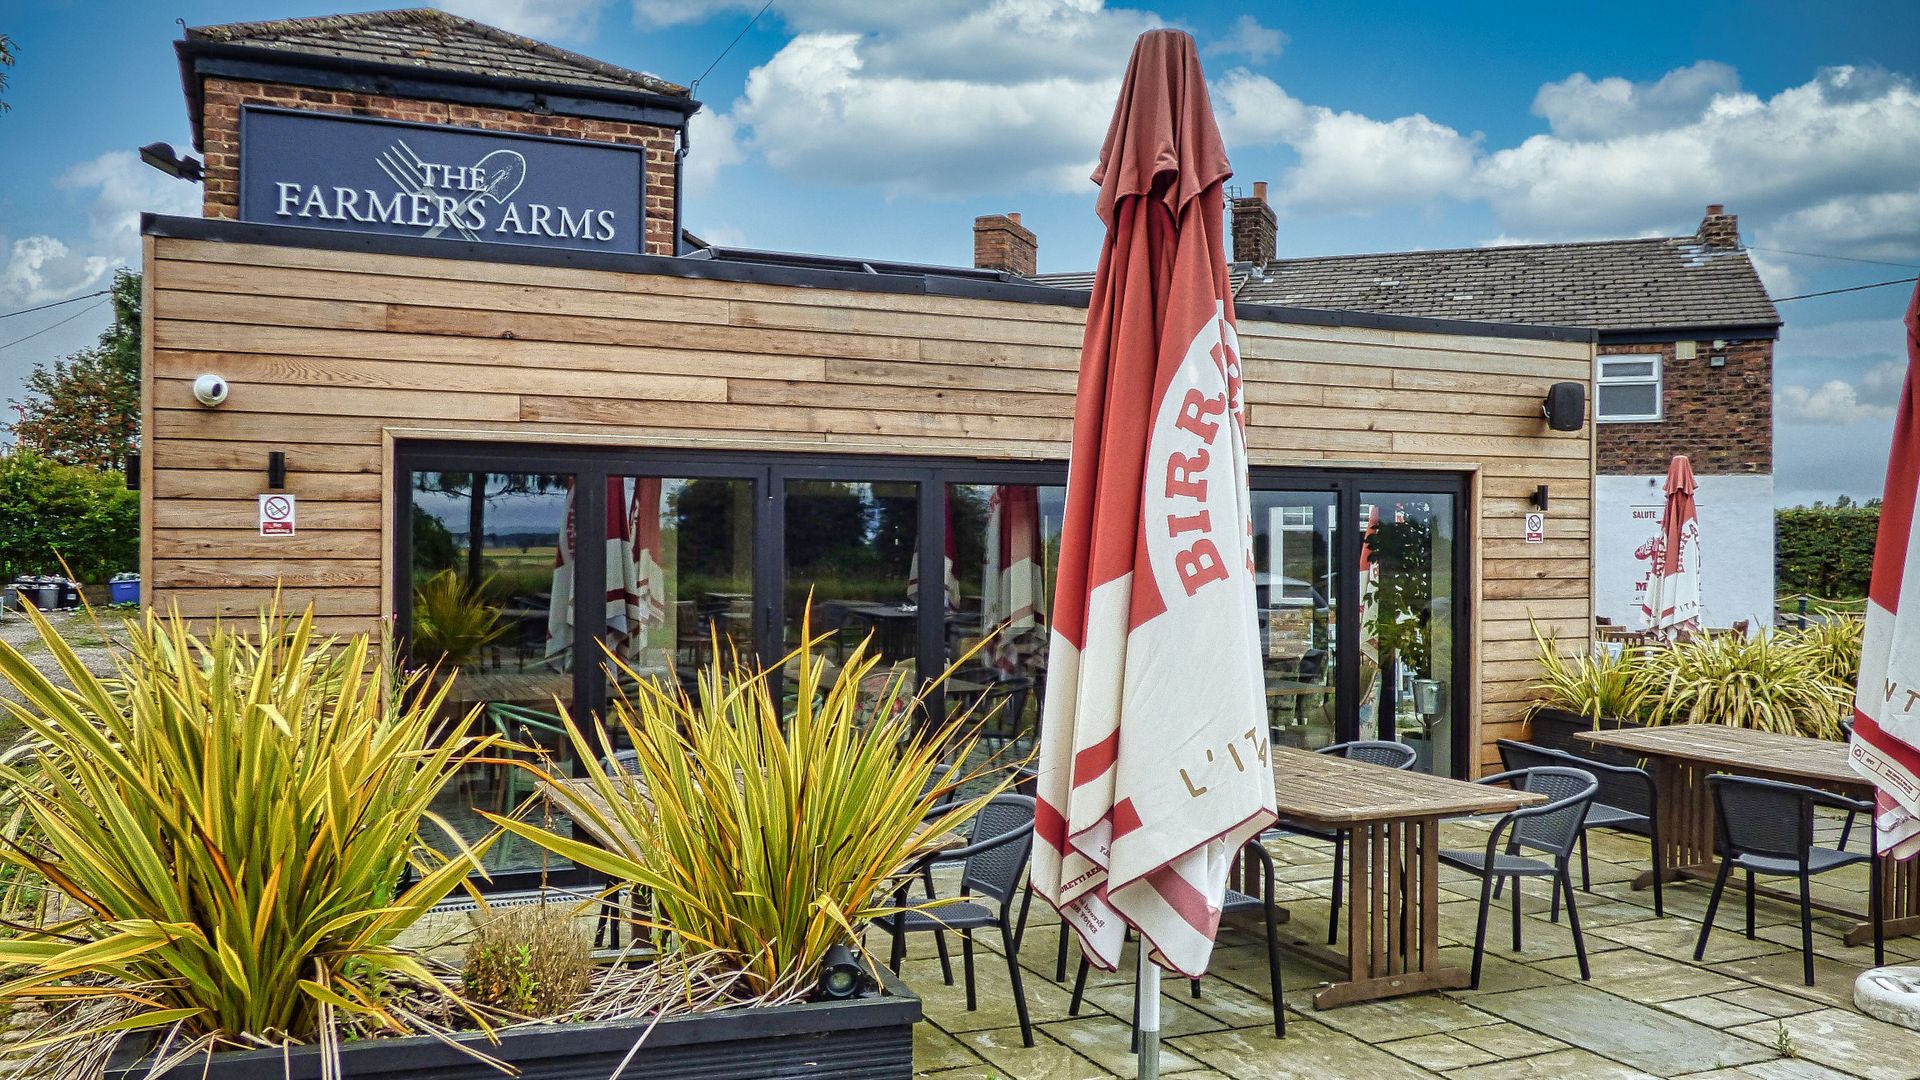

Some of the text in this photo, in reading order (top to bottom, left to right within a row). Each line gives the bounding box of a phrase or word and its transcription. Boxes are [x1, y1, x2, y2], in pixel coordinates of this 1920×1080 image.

[417, 162, 488, 193] THE
[275, 182, 616, 242] FARMERS ARMS
[1632, 510, 1657, 519] SALUTE
